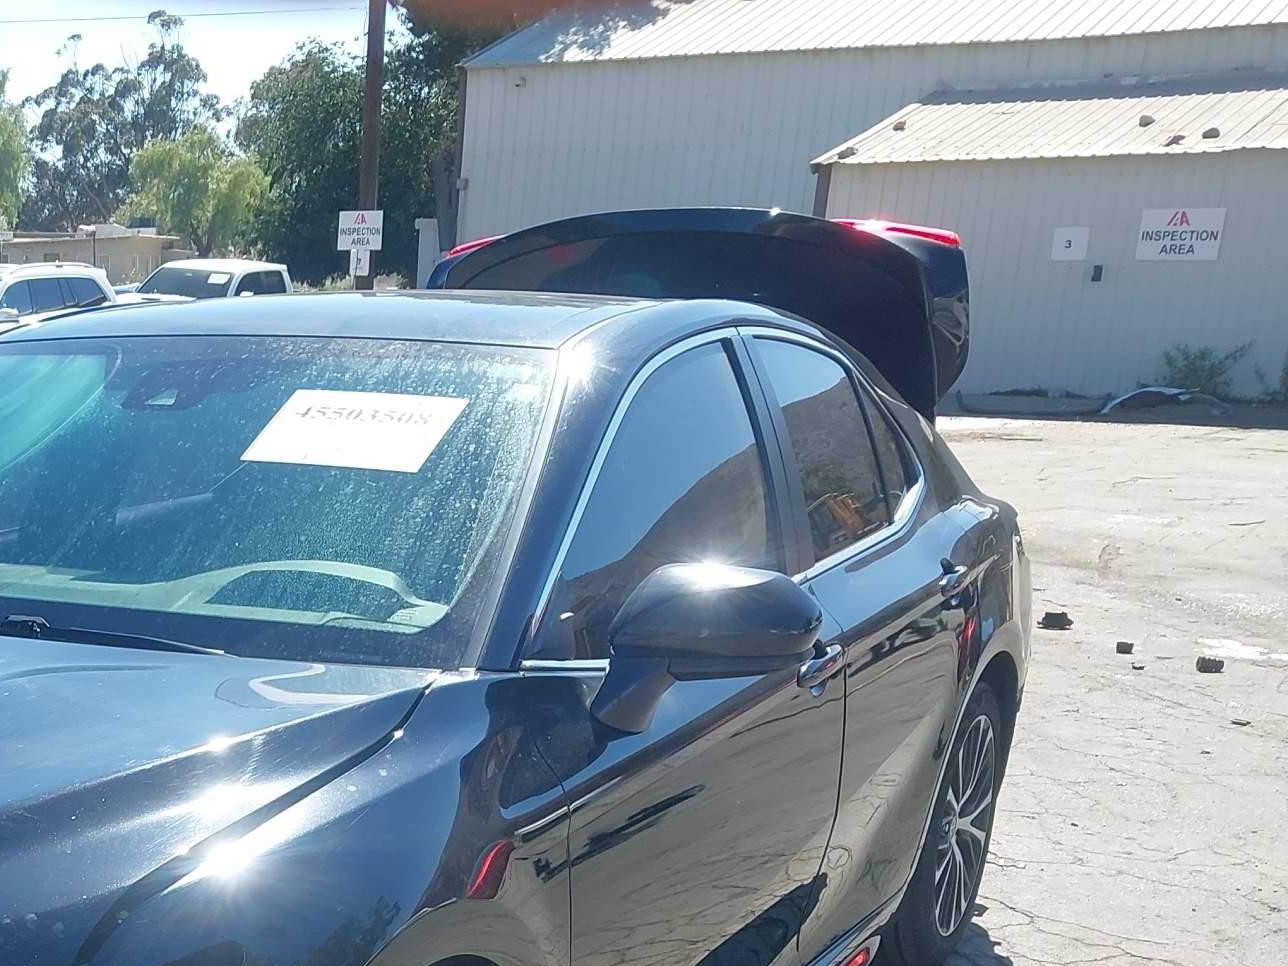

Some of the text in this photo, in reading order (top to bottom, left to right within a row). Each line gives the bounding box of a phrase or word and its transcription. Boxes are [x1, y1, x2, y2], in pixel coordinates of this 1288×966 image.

[340, 227, 381, 236] INSPECTION
[1141, 230, 1219, 242] INSPECTION
[351, 238, 370, 246] AREA
[1064, 240, 1072, 249] 3
[1159, 244, 1195, 255] AREA
